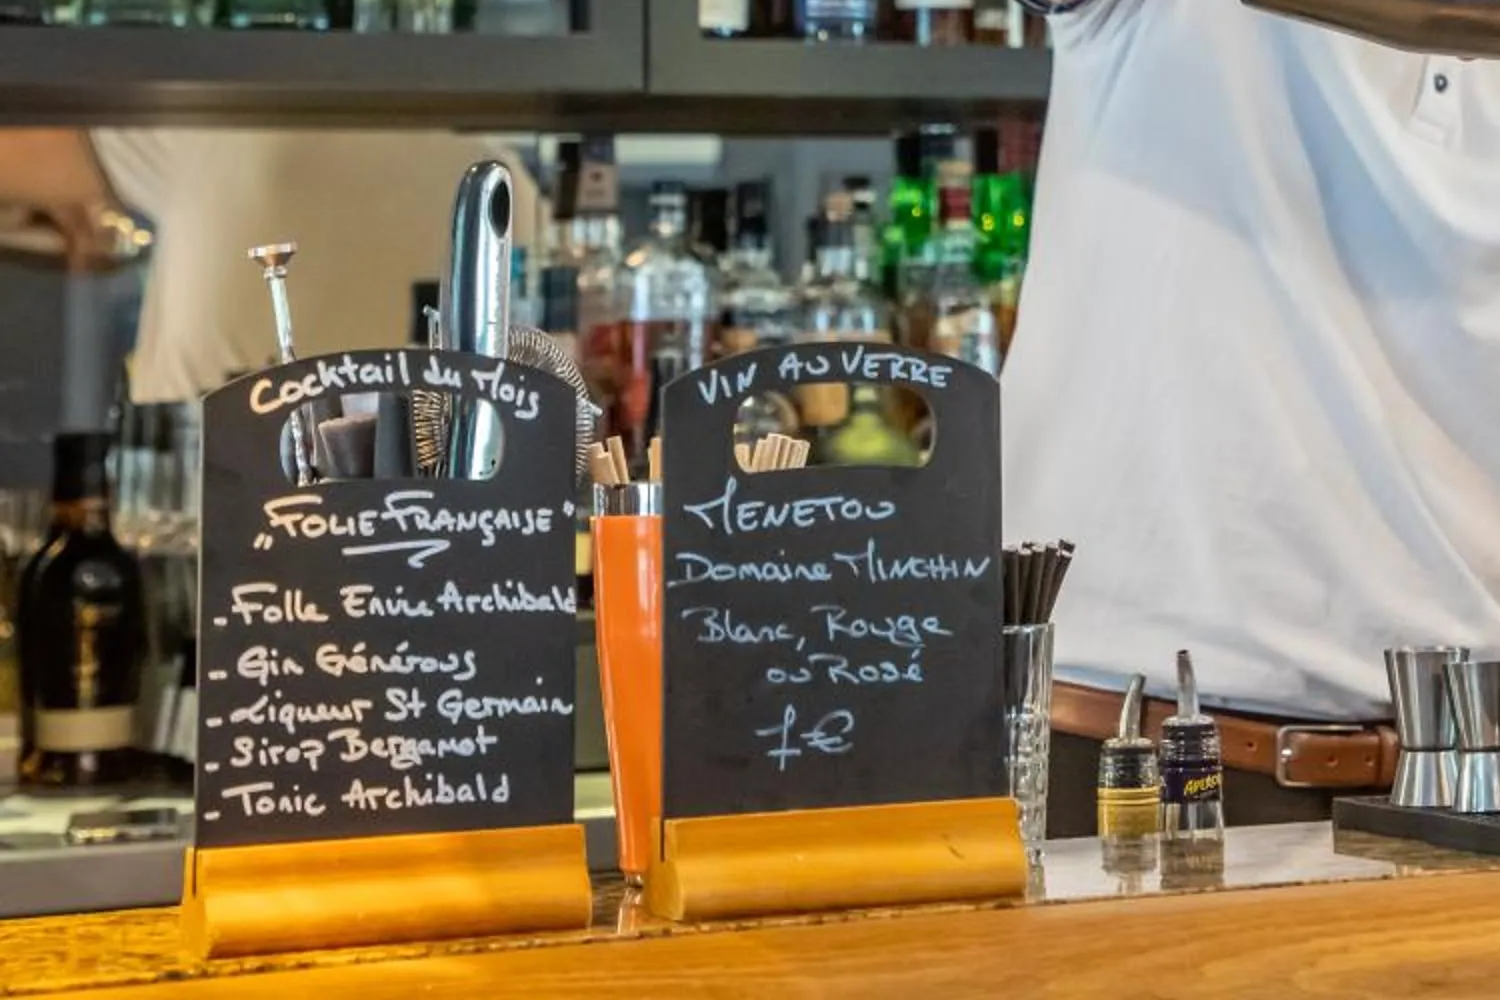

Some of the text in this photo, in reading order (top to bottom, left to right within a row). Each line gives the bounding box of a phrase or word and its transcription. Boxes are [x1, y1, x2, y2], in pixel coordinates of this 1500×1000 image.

[250, 352, 540, 420] Cocktail du Mois
[698, 345, 953, 405] VIN AU VERRE
[683, 476, 897, 536] MENETOU
[666, 538, 990, 589] Domaine MINCHIN
[231, 582, 330, 626] Folle
[339, 584, 435, 617] Envie
[436, 580, 577, 615] Archibald
[681, 604, 954, 651] Blanc, Rouge
[236, 645, 304, 684] Gin
[766, 649, 925, 685] ou Rosé
[229, 689, 373, 733] Liqueur
[384, 687, 427, 722] St
[437, 676, 574, 723] Germain
[230, 736, 327, 771] Sirop
[327, 725, 498, 770] Bergamot
[222, 782, 327, 817] Tonic
[340, 773, 511, 811] Archibald
